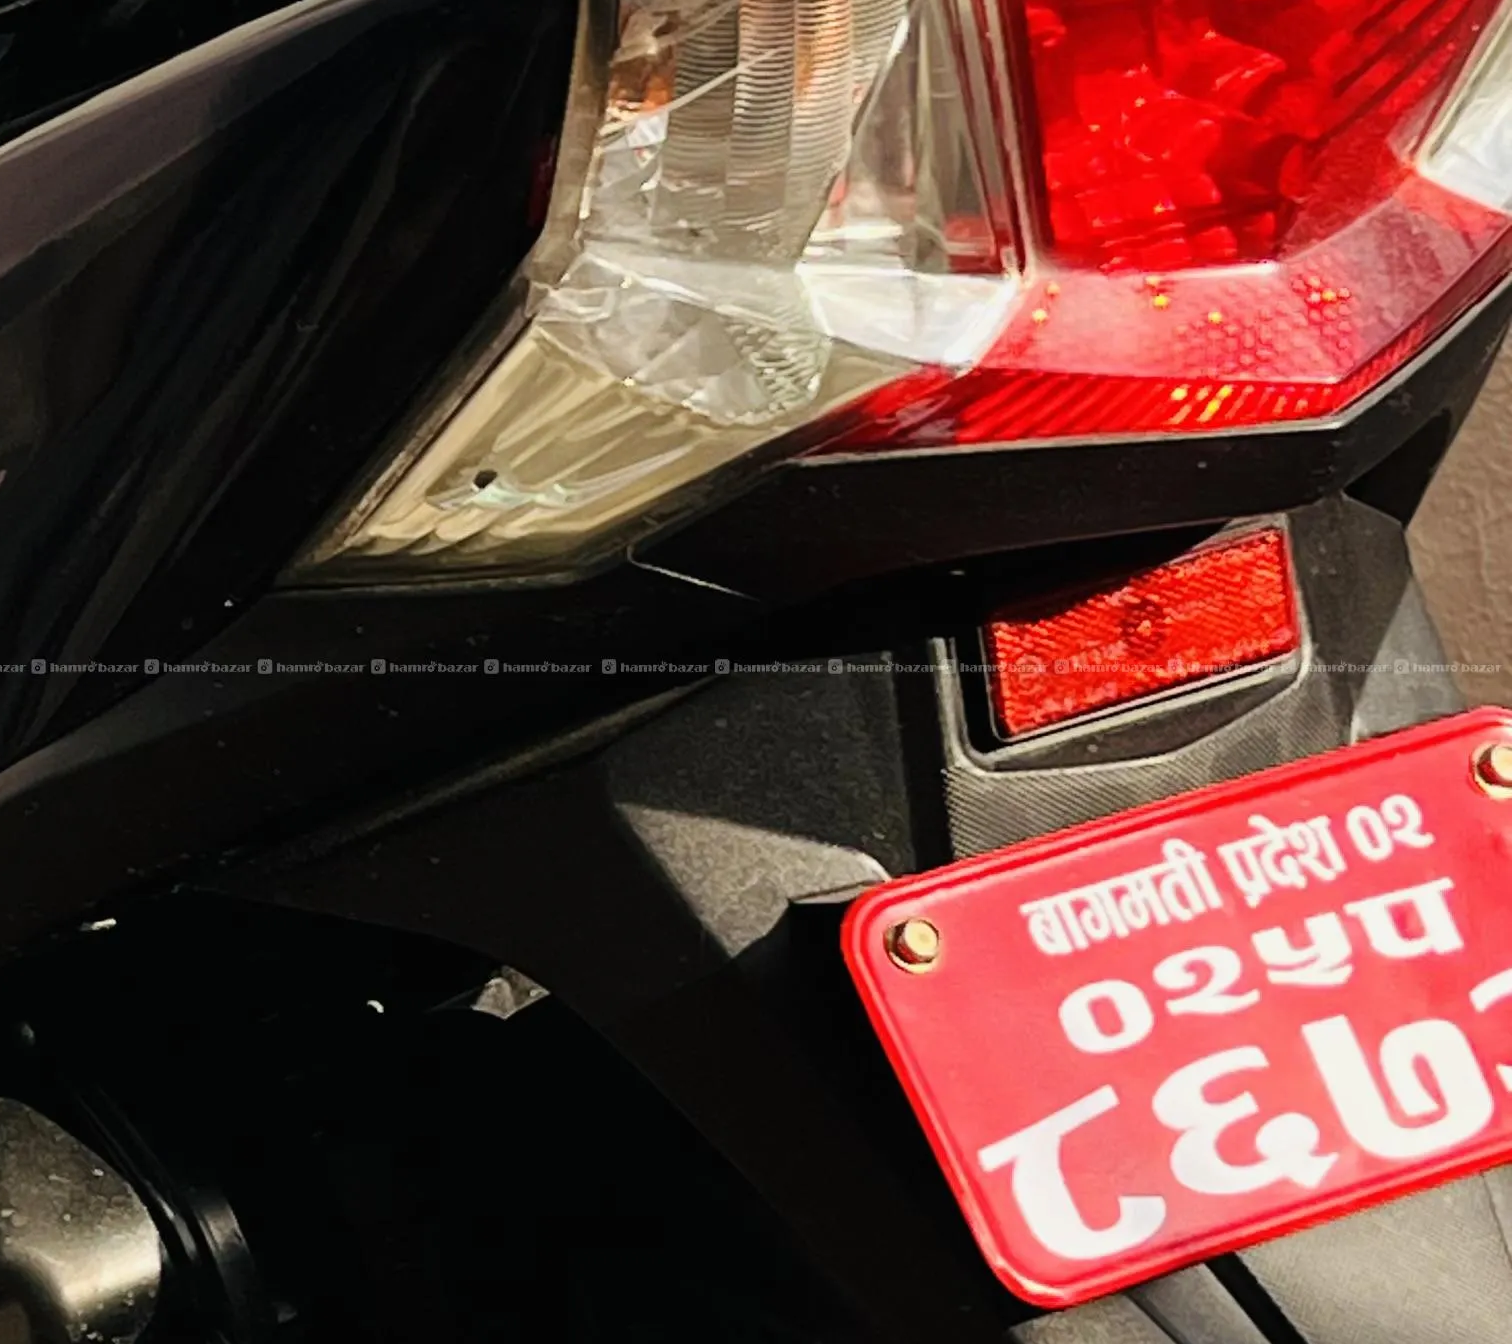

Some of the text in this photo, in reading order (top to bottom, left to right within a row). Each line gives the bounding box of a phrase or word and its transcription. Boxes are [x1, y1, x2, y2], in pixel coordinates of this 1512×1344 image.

[1019, 794, 1434, 955] बागमती प्रदेश ०२
